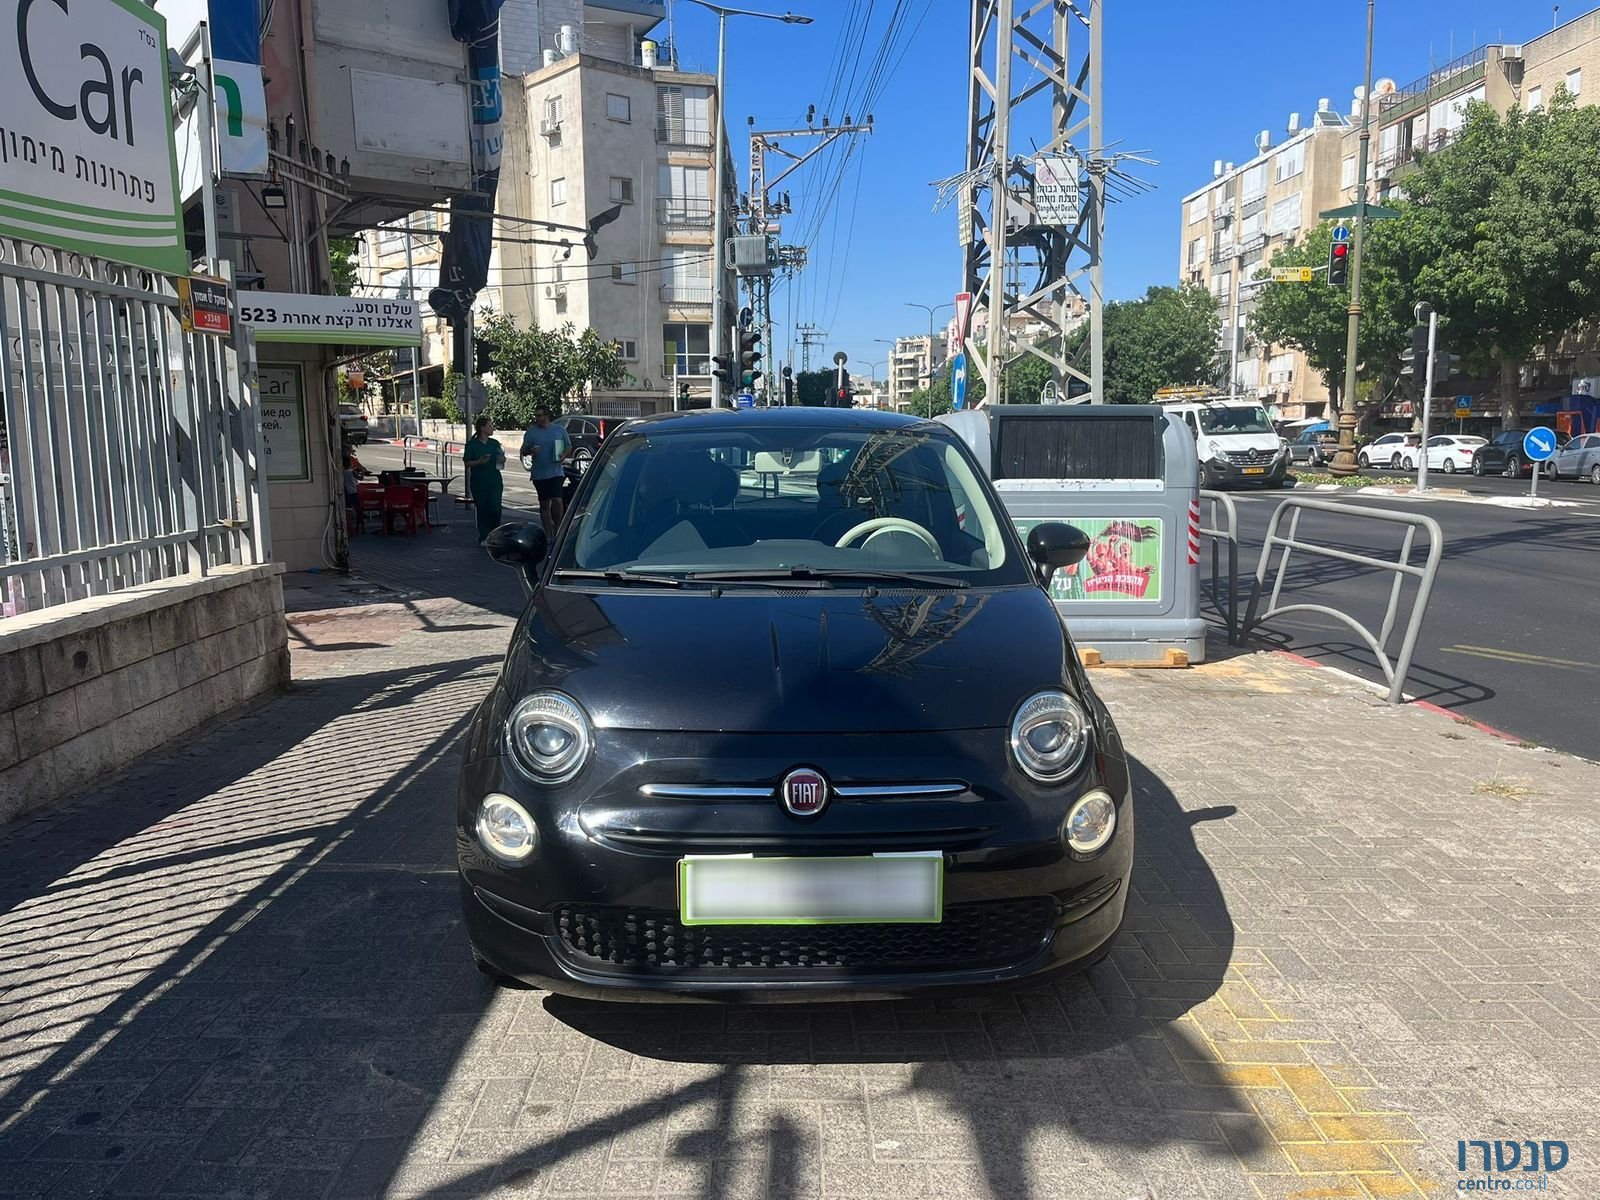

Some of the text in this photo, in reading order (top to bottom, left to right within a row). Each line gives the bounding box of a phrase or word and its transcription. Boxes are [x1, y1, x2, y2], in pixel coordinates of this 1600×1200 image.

[17, 0, 143, 147] Car
[0, 127, 156, 203] פתרונות מימון
[240, 307, 277, 323] 523
[342, 303, 412, 315] שלם וסע...
[282, 312, 413, 329] אצלנו זה קצת אחרת
[278, 409, 291, 418] до
[792, 783, 818, 804] FIAT
